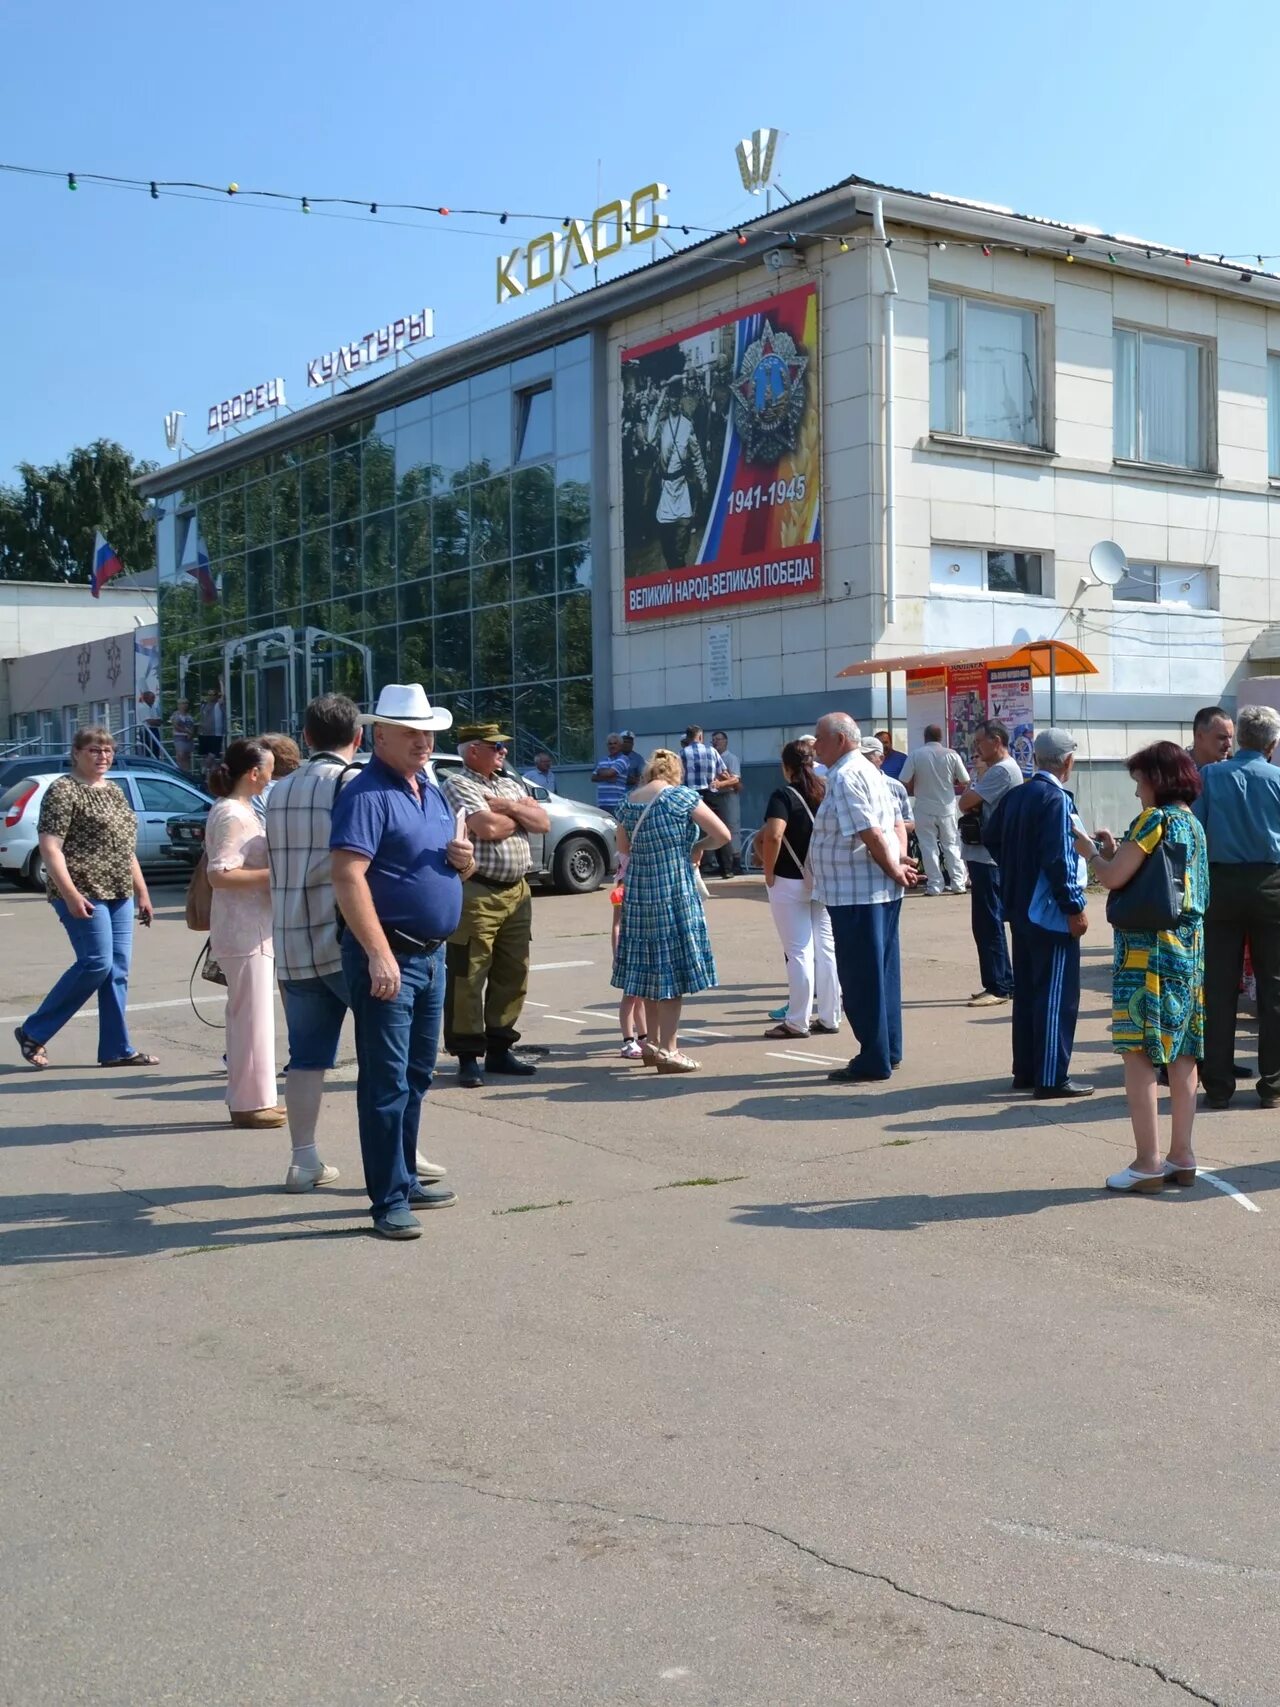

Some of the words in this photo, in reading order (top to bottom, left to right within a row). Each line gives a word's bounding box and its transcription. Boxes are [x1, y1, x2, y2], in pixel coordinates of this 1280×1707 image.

[496, 182, 669, 304] КОЛОС
[207, 377, 286, 434] ДВОРЕЦ
[307, 307, 434, 388] КУЛЬТУРЫ
[727, 474, 806, 515] 1941-1945
[629, 577, 673, 611] ВЕЛИКИЙ
[675, 565, 761, 602] НАРОД-ВЕЛИКАЯ
[763, 556, 814, 587] ПОБЕДА!
